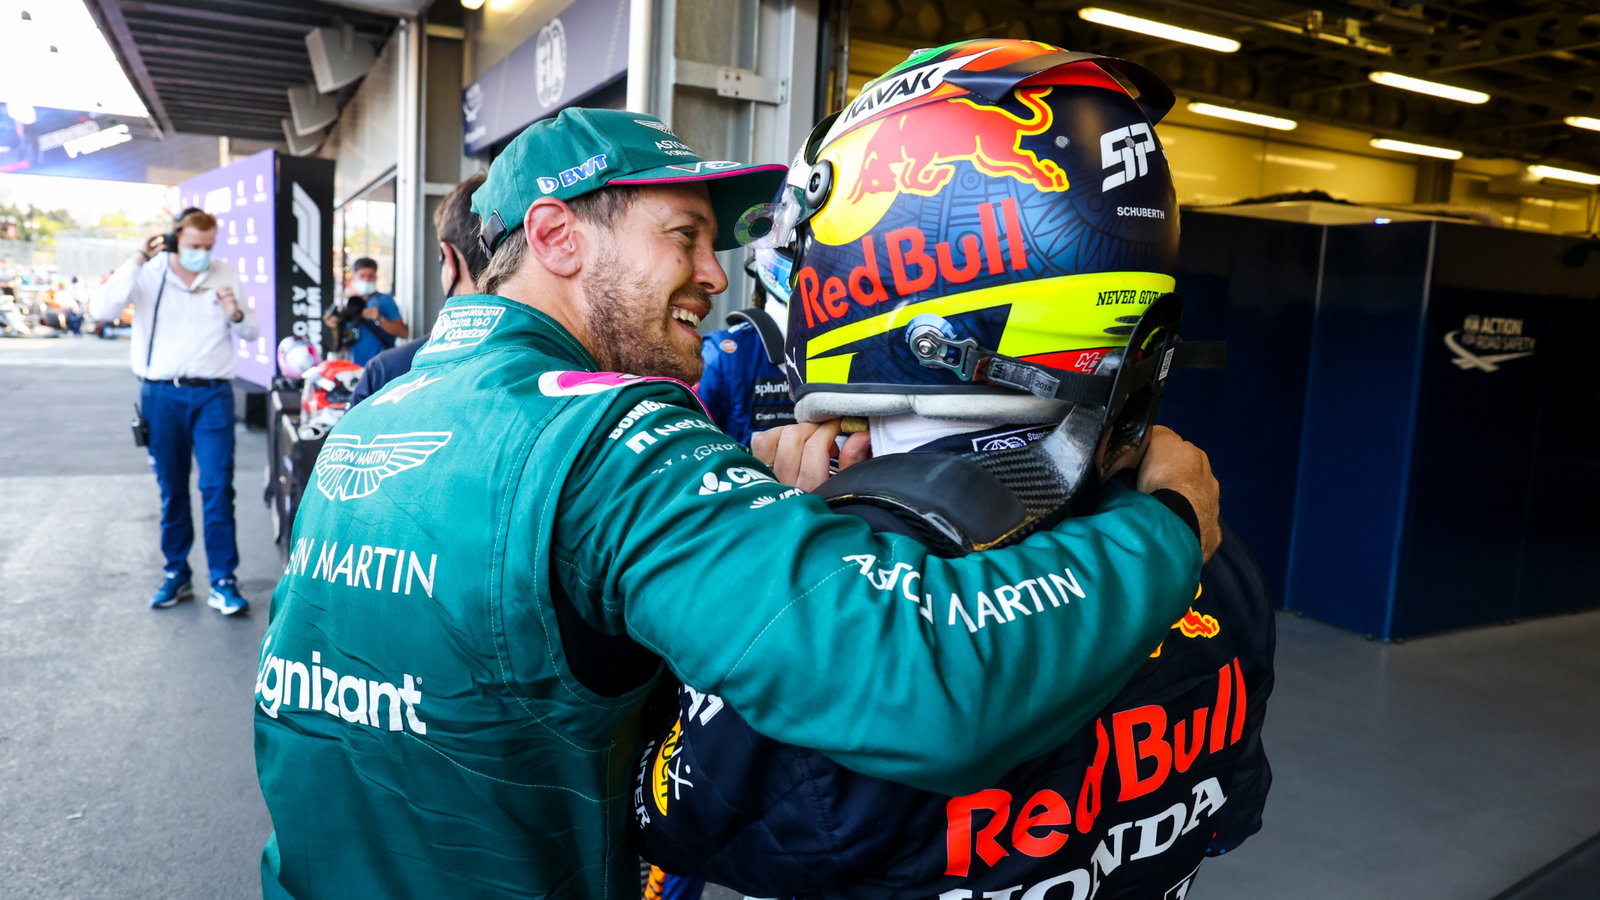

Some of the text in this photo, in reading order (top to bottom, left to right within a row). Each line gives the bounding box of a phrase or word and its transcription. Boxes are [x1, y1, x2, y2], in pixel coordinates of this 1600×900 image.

[844, 67, 940, 123] KAVAK
[655, 140, 692, 152] ASTO
[1100, 122, 1156, 193] SP
[559, 154, 608, 188] BWT
[1117, 206, 1165, 219] SCHUBERTH
[798, 197, 1027, 329] Red Bull
[1096, 290, 1136, 306] NEVER
[1481, 318, 1523, 335] ACTION
[1476, 336, 1502, 350] ROAD
[1503, 337, 1536, 352] SAFETY
[654, 419, 723, 434] NetA
[327, 448, 391, 465] ASTON MARTIN
[312, 540, 438, 598] MARTIN
[255, 634, 427, 735] gnizant
[944, 657, 1247, 877] Red Bull
[938, 777, 1227, 900] ONDA
